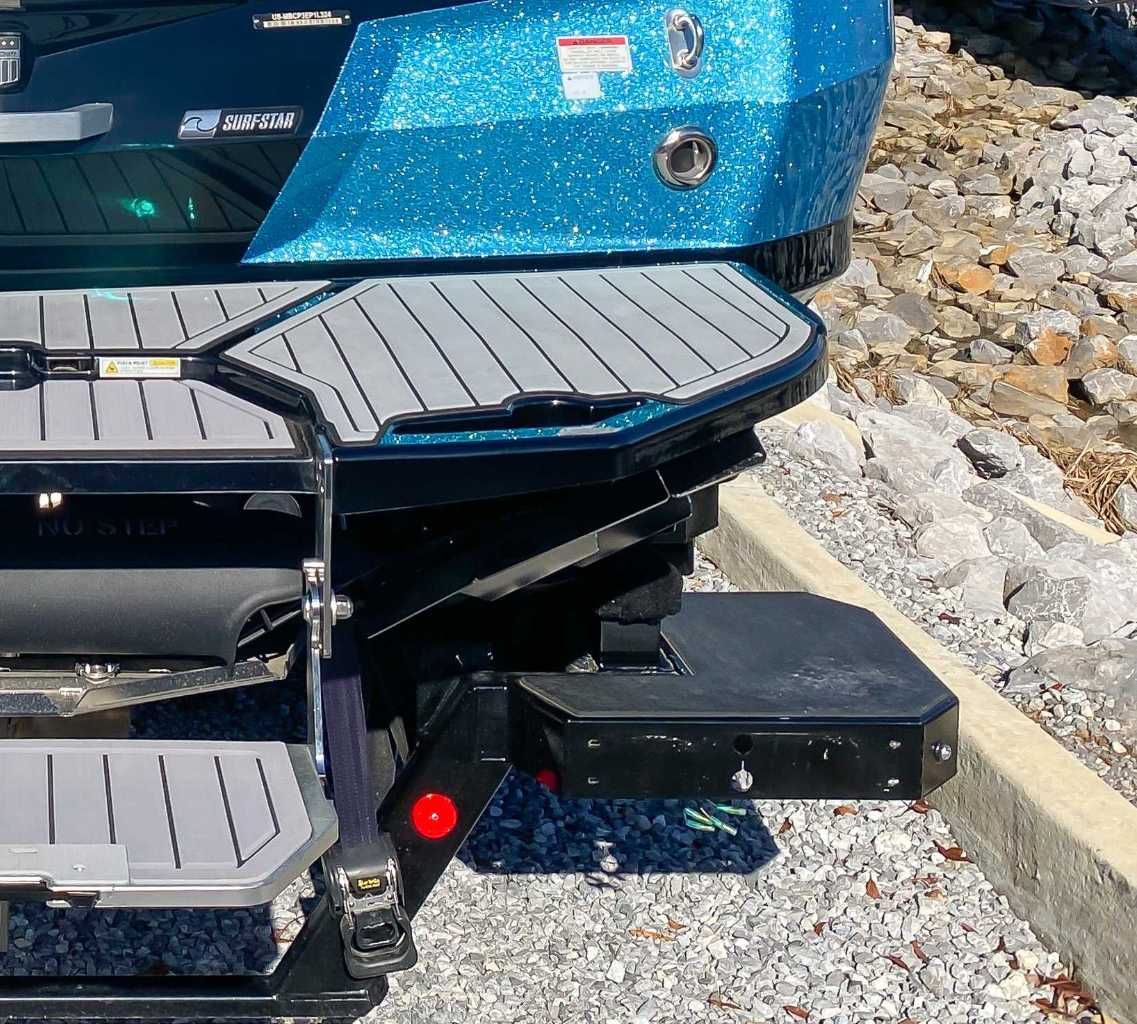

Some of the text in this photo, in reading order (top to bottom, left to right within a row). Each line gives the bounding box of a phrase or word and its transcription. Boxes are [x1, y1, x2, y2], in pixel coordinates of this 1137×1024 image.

[223, 112, 295, 131] SURFSTAR
[38, 520, 178, 536] NO STEP
